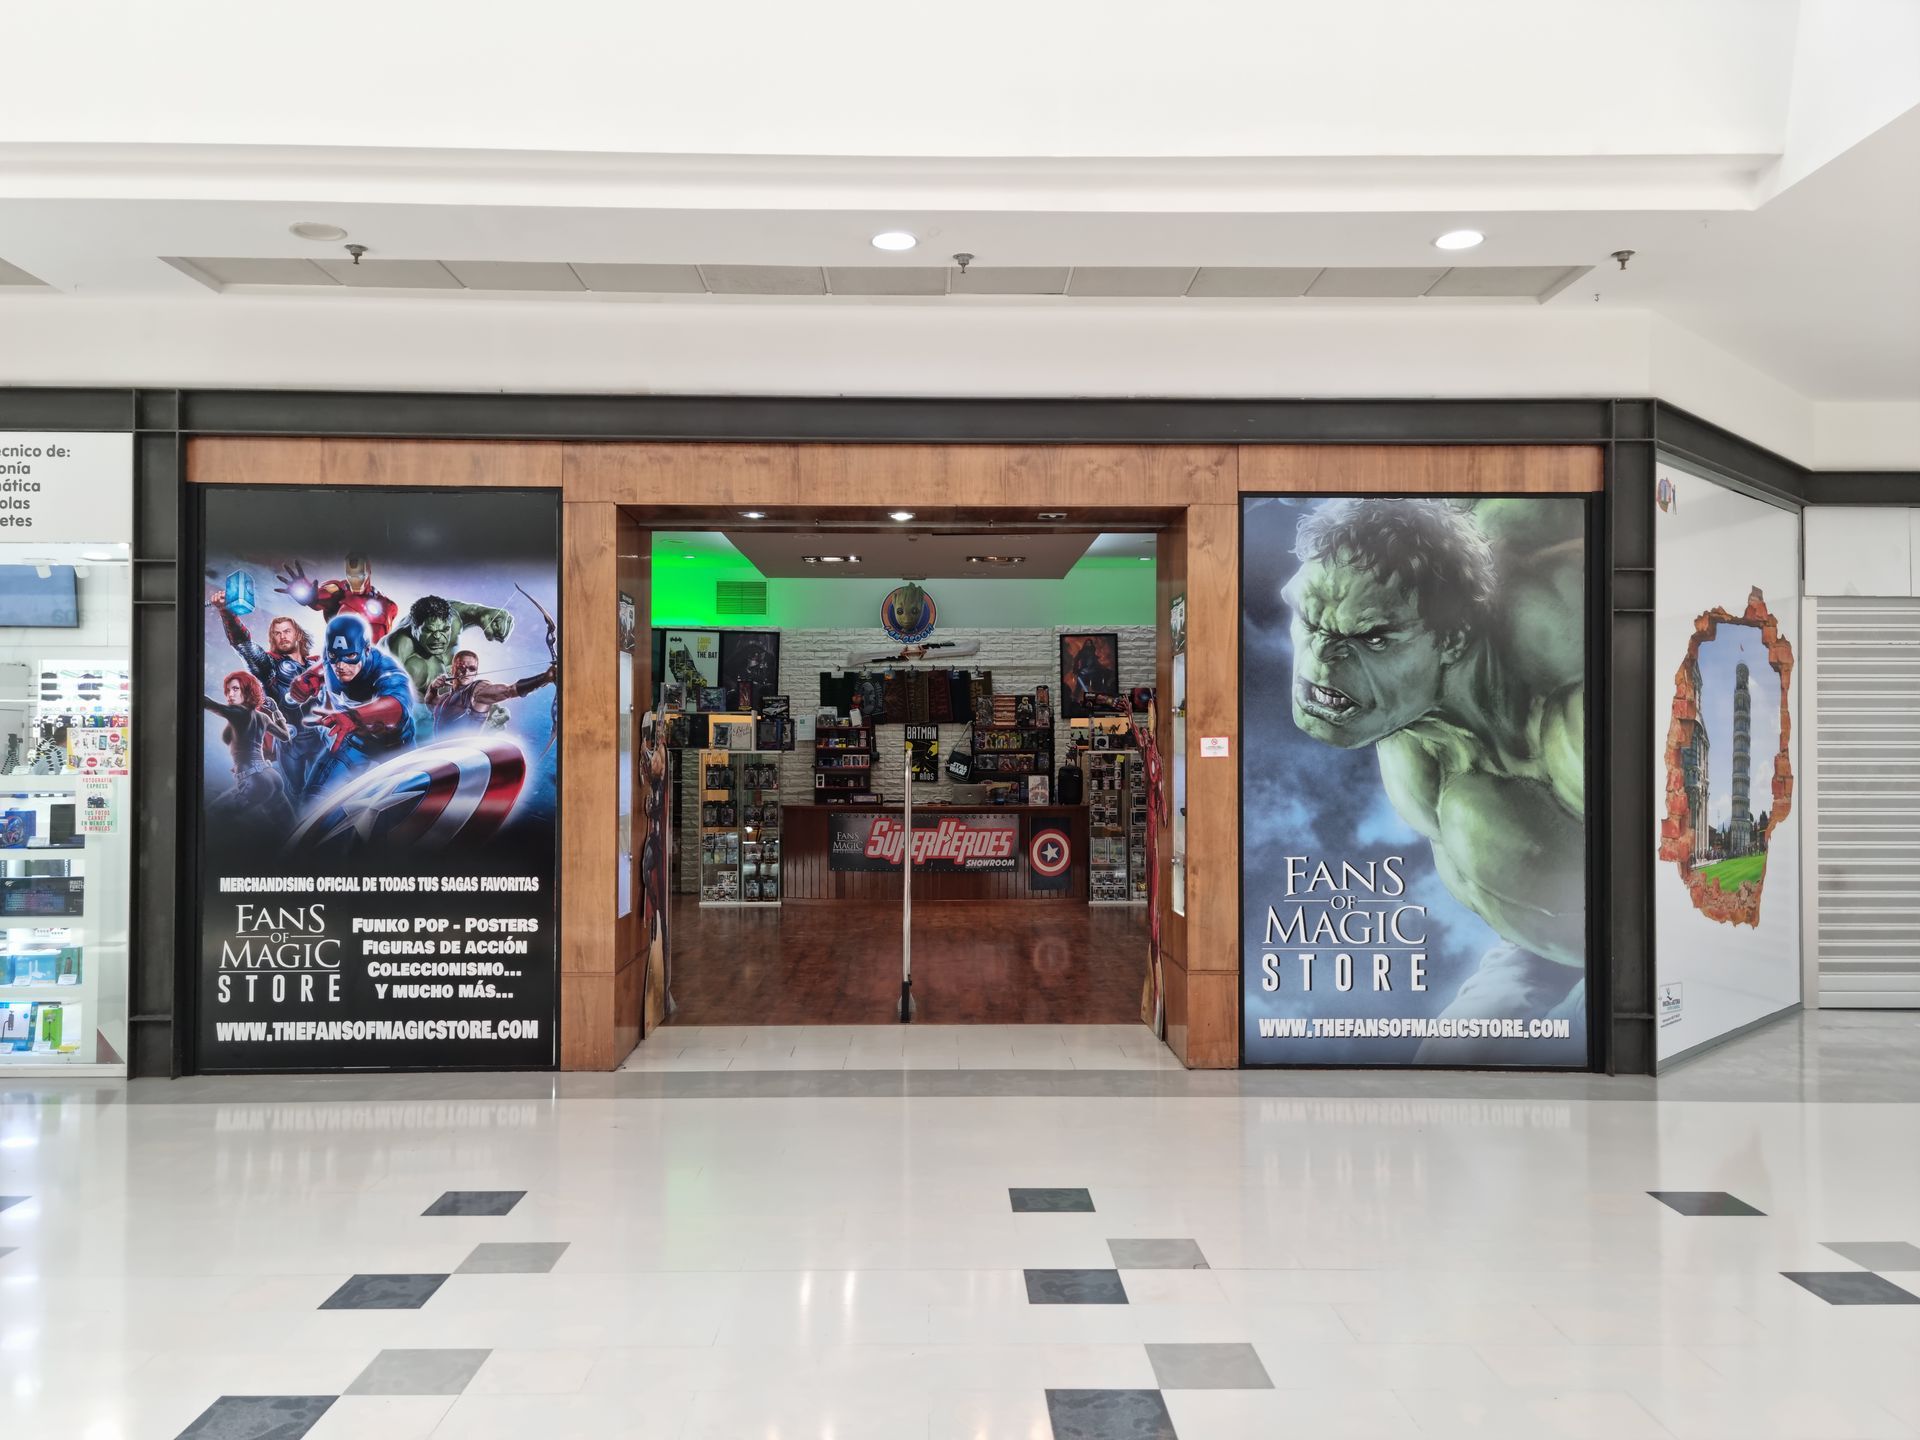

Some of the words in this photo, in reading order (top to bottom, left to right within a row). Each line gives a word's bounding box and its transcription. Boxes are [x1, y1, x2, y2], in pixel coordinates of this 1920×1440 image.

[0, 444, 42, 457] cnico
[46, 444, 70, 457] de:
[0, 478, 40, 492] ática
[0, 496, 30, 509] olas
[0, 514, 32, 526] etes
[906, 726, 936, 740] BATMAN
[950, 762, 968, 770] STAR
[950, 766, 967, 776] WARS
[837, 832, 859, 840] FANS
[833, 841, 864, 851] MAGIC
[966, 859, 1015, 867] SHOWROOM
[1284, 856, 1406, 896] FANS
[220, 877, 314, 892] MERCHANDISING
[317, 877, 360, 891] OFICIAL
[362, 877, 377, 891] DE
[379, 877, 415, 891] TODAS
[417, 877, 439, 891] TUS
[441, 877, 478, 891] SAGAS
[480, 877, 539, 891] FAVORITAS
[1330, 895, 1358, 910] OF
[236, 904, 325, 934] FANS
[352, 918, 409, 933] FUNKO
[414, 918, 449, 933] POP
[465, 918, 538, 932] POSTERS
[1262, 905, 1428, 944] MAGIC
[270, 932, 290, 943] OF
[363, 940, 435, 954] FIGURAS
[440, 941, 460, 954] DE
[465, 936, 527, 954] ACCIÓN
[218, 939, 340, 968] MAGIC
[367, 962, 522, 977] COLECCIONISMO...
[1262, 953, 1428, 992] STORE
[218, 974, 340, 1002] STORE
[375, 984, 388, 999] Y
[393, 985, 453, 998] MUCHO
[458, 981, 513, 998] MÁS...
[216, 1020, 538, 1041] WWW.THEFANSOFMAGICSTORE.COM
[1259, 1018, 1570, 1038] WWW.THEFANSOFMAGICSTORE.COM
